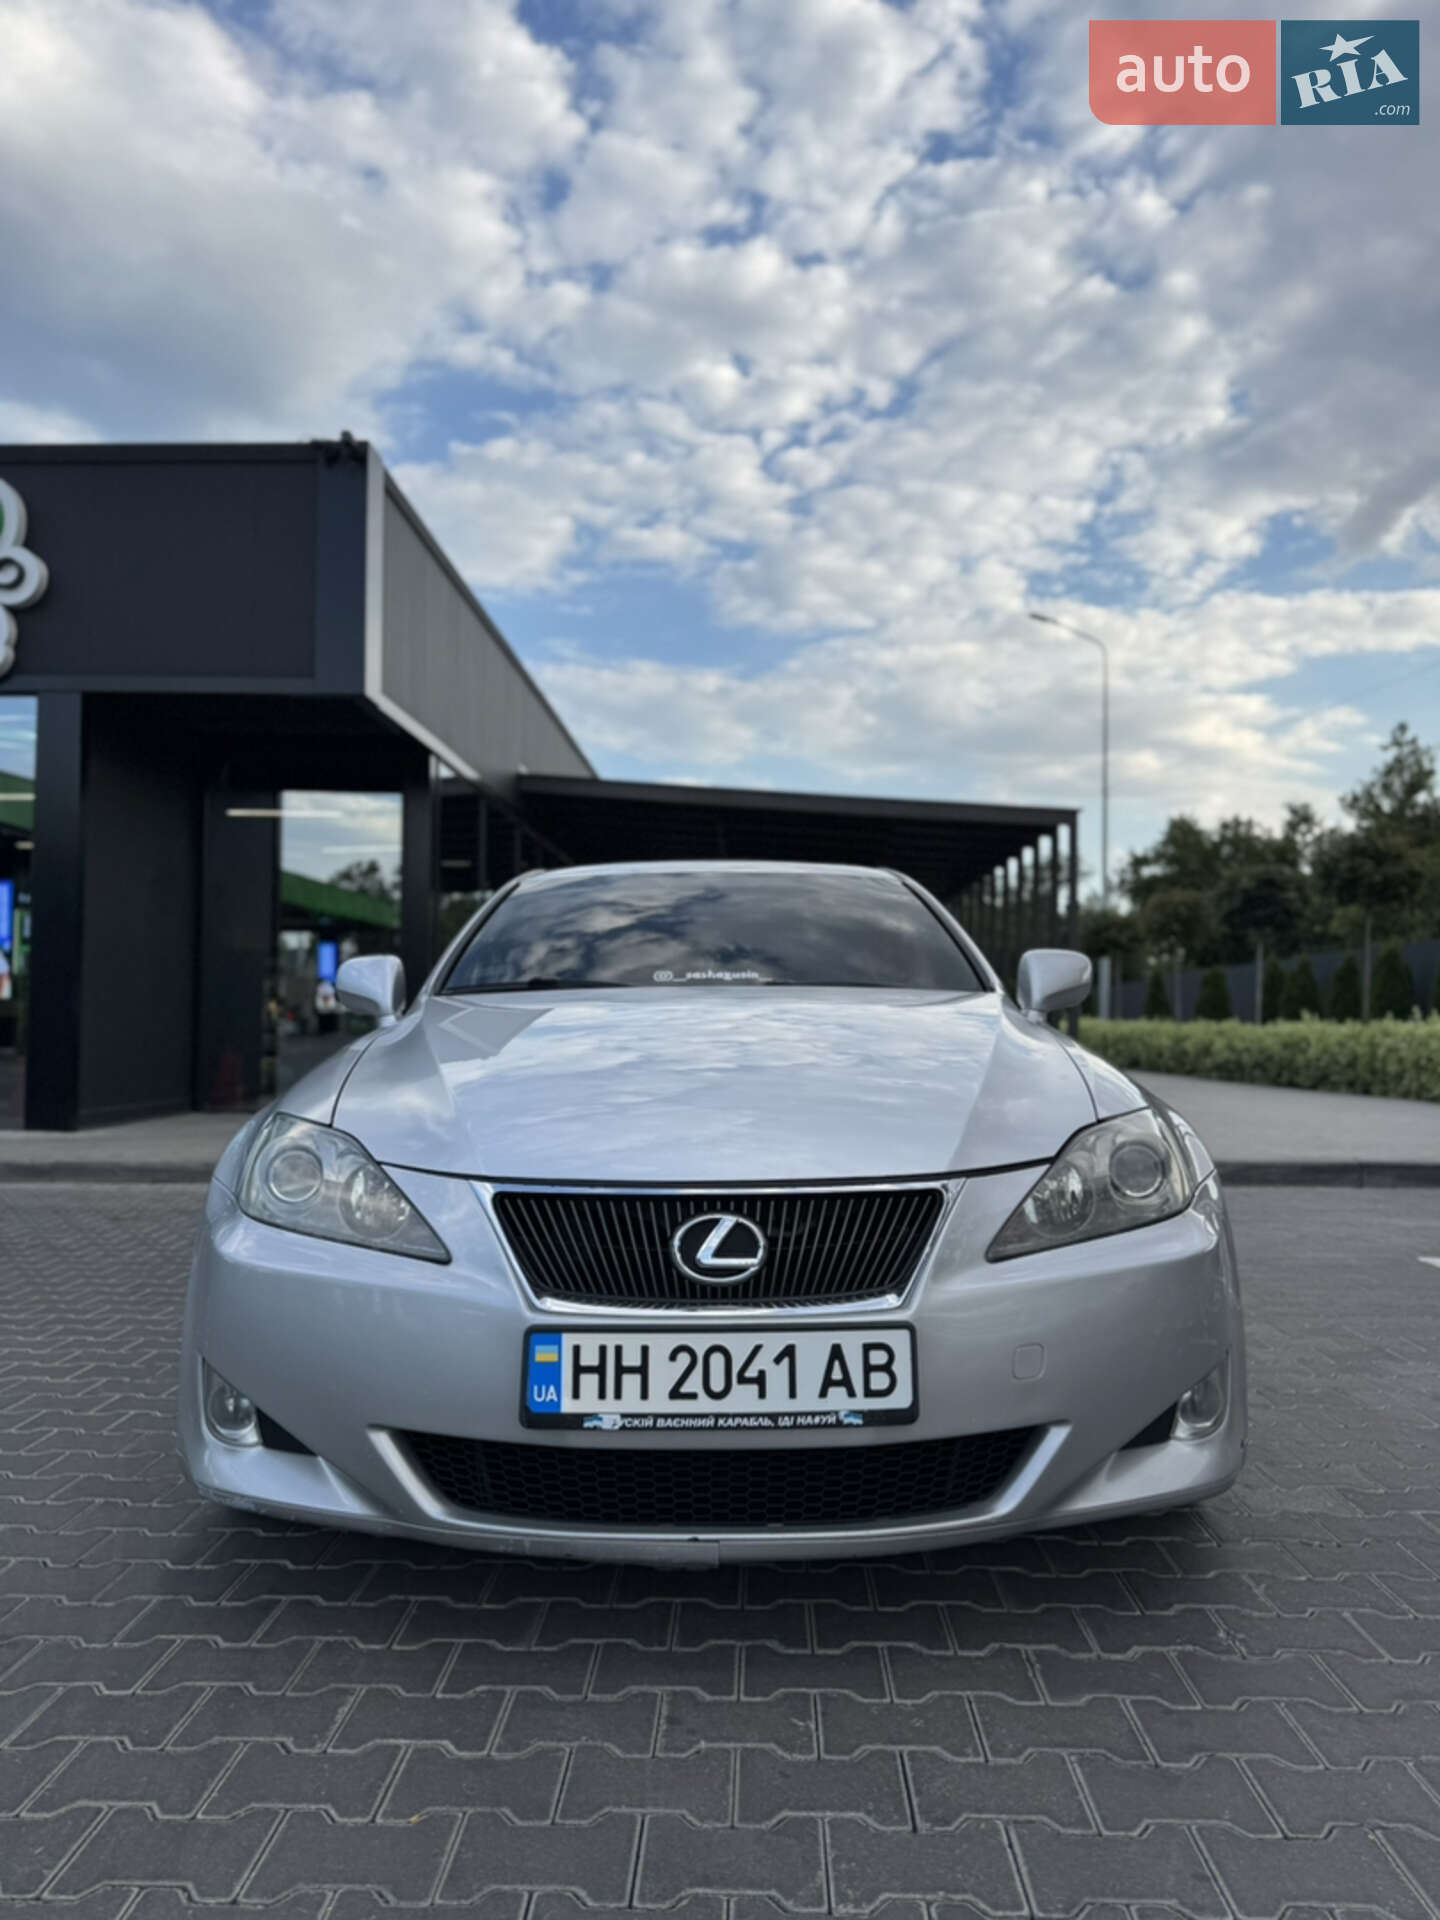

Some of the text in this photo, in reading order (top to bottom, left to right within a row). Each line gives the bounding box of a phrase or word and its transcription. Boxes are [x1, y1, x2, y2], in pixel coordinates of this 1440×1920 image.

[571, 1342, 898, 1400] HH 2041 AB
[533, 1384, 559, 1402] UA
